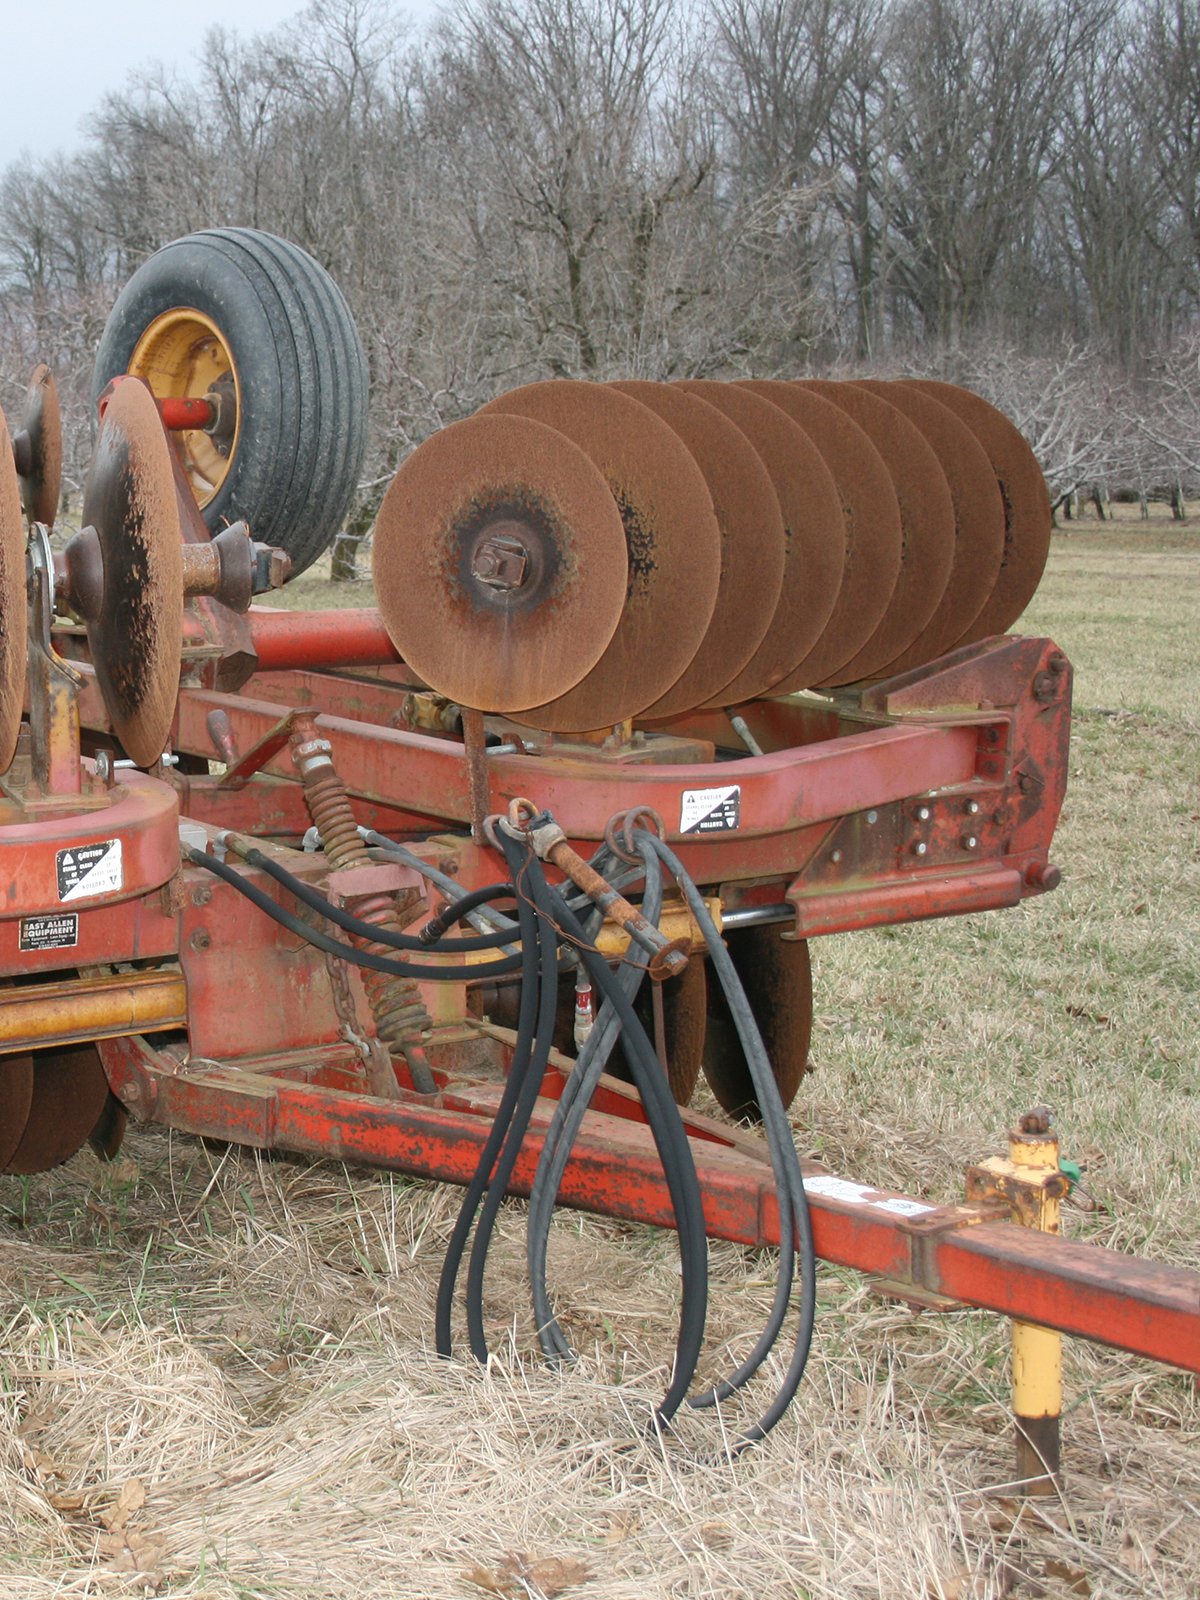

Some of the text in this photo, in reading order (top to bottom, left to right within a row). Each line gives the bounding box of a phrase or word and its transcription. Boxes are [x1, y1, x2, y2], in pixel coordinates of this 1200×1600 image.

[77, 849, 104, 860] CAUTION
[23, 922, 45, 931] EAST
[47, 919, 74, 929] ALLEN
[23, 926, 74, 938] EQUIPMENT
